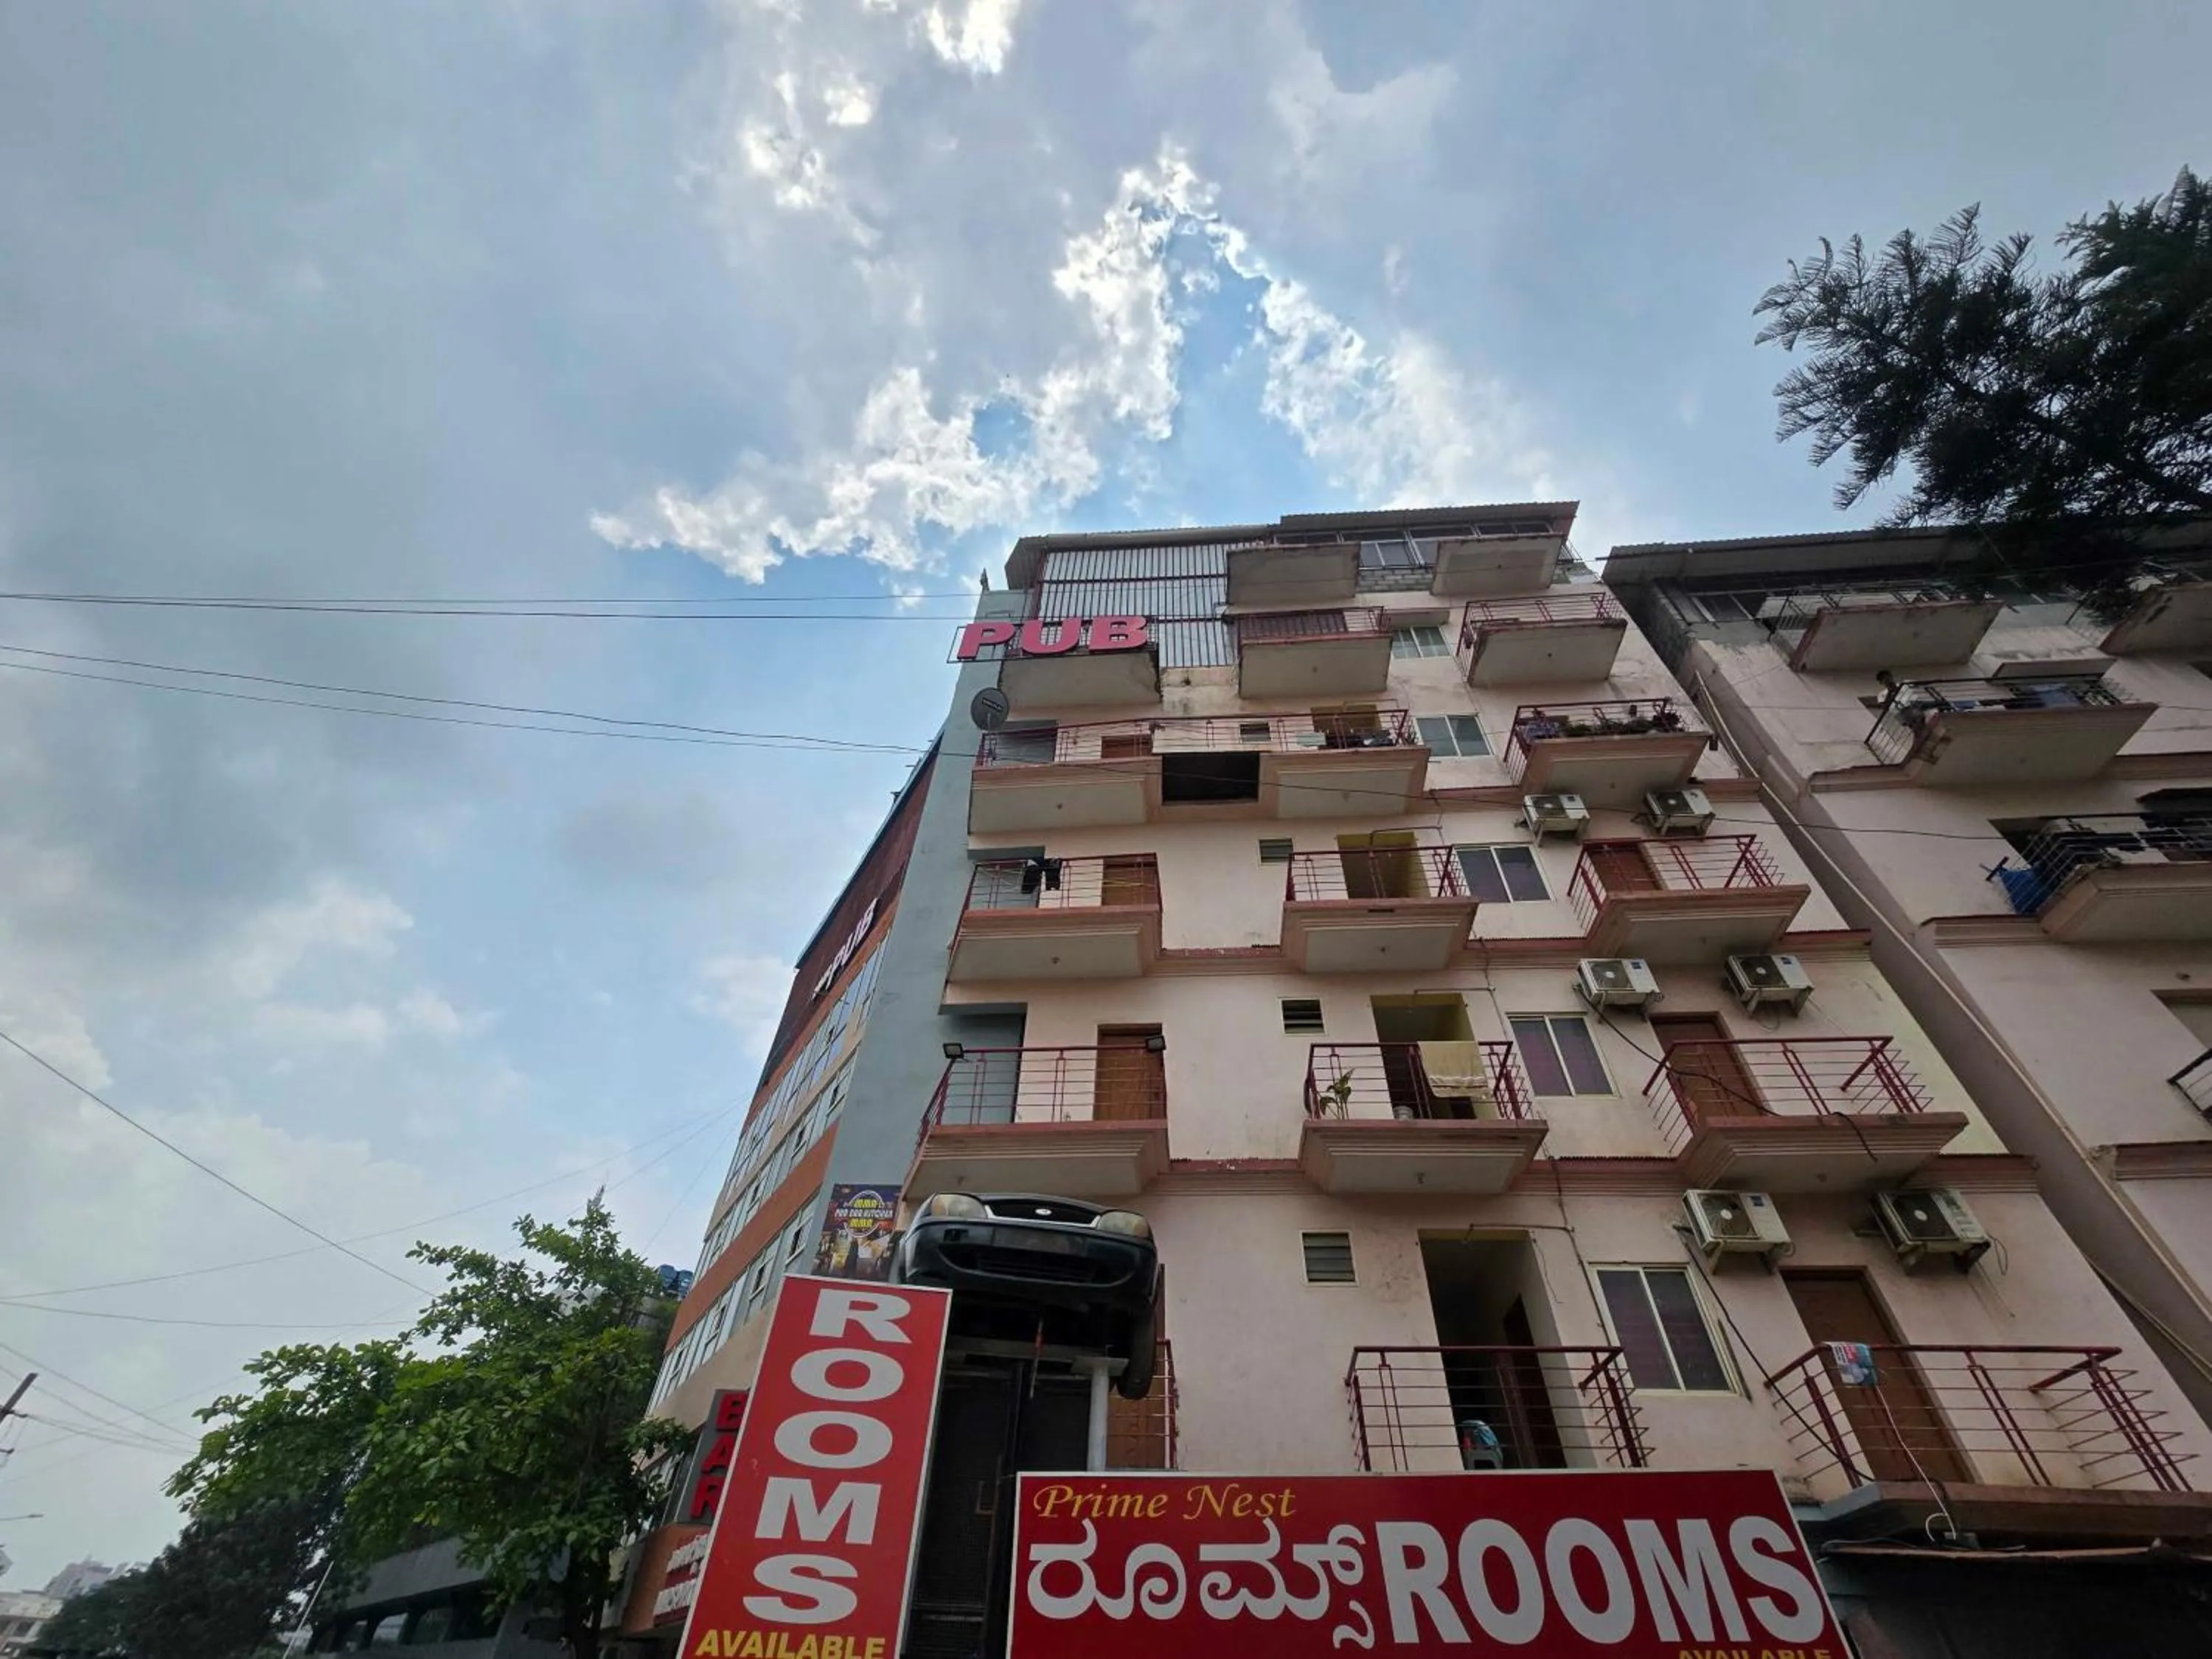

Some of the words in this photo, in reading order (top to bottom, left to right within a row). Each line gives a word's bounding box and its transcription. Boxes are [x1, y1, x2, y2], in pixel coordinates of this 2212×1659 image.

[957, 616, 1147, 661] PUB
[690, 1392, 748, 1519] BAR
[742, 1288, 912, 1624] ROOMS
[1033, 1484, 1169, 1518] Prime
[1183, 1484, 1296, 1520] Nest
[1375, 1515, 1824, 1644] ROOMS
[695, 1628, 886, 1659] AVAILABLE
